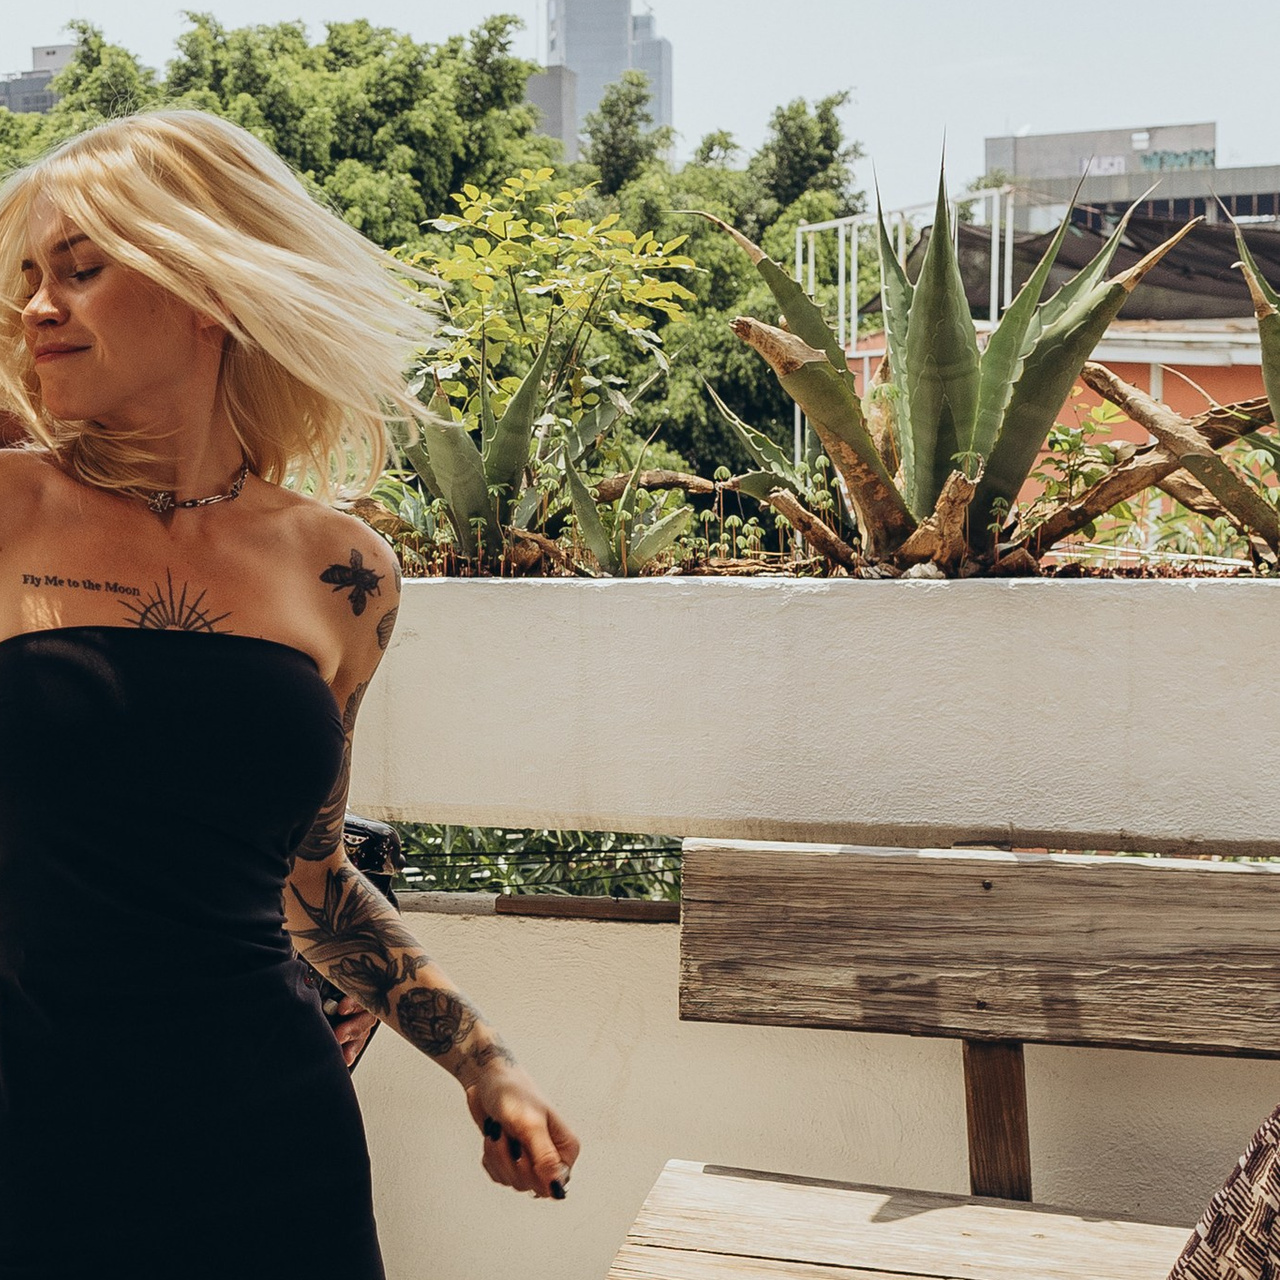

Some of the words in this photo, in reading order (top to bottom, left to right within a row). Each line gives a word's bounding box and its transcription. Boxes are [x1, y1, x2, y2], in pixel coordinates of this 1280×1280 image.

[22, 574, 41, 587] Fly
[45, 575, 64, 586] Me
[67, 578, 80, 588] to
[83, 580, 101, 591] the
[105, 582, 140, 596] Moon
